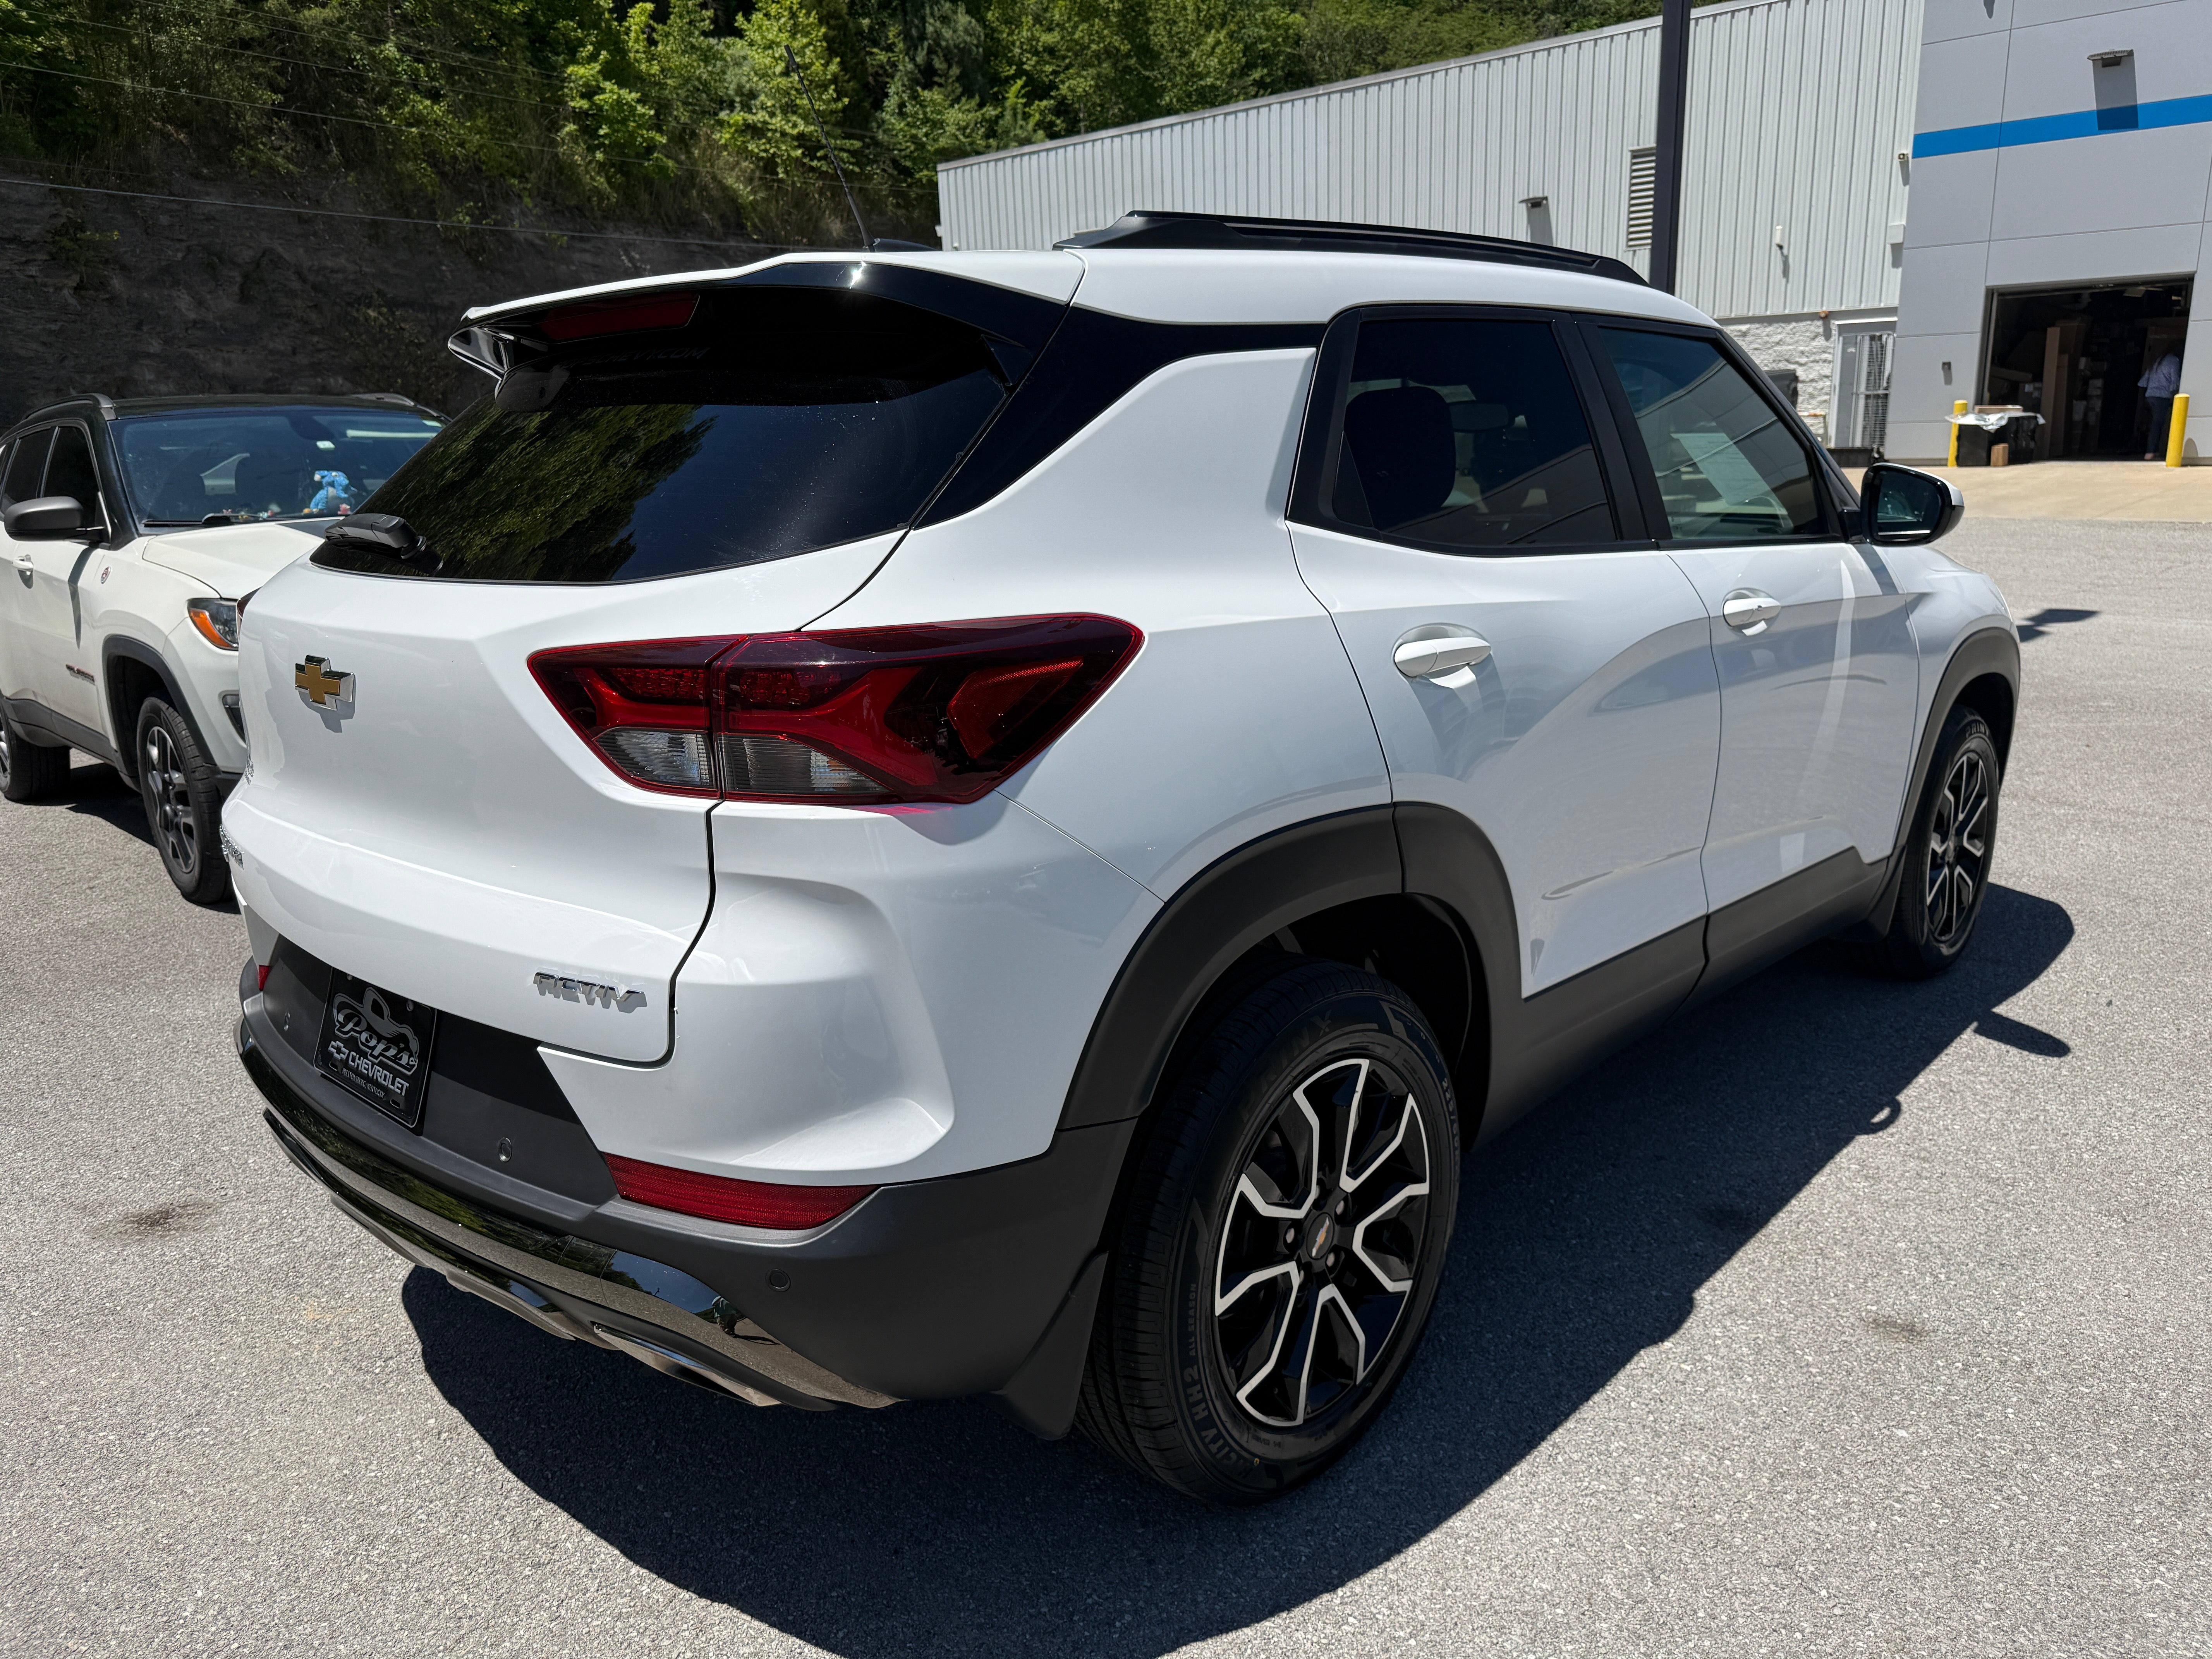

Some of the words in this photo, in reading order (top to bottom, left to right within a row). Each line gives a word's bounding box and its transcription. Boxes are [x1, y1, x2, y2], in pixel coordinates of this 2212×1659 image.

[349, 1051, 409, 1096] CHEVROLET
[1188, 1283, 1197, 1332] SEASON
[1183, 1365, 1209, 1421] HH2
